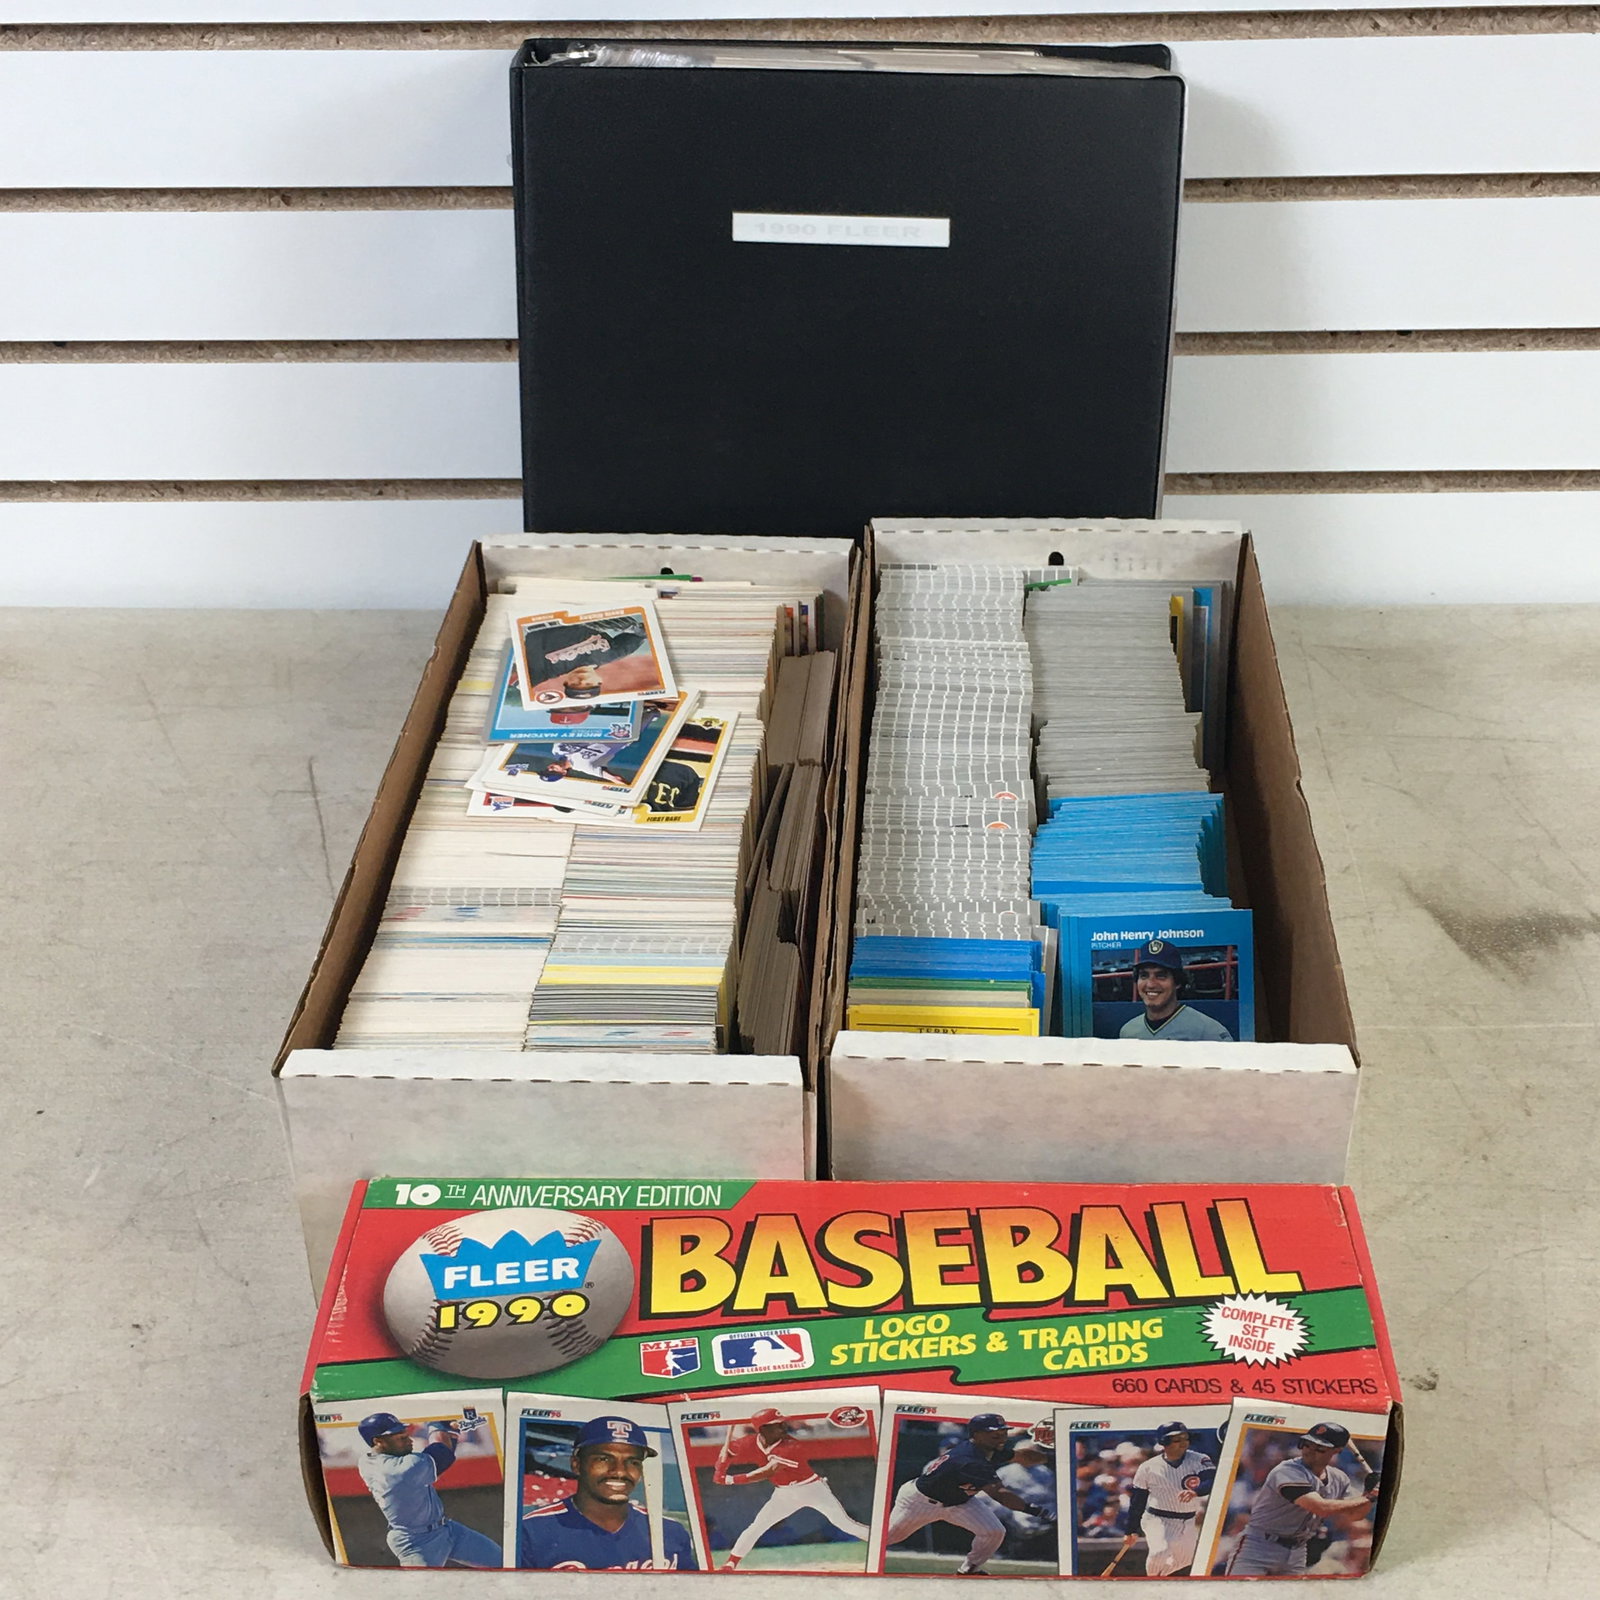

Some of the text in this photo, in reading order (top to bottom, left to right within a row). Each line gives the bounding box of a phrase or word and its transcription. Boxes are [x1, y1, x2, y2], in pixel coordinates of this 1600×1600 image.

[755, 222, 921, 239] 1990 FLEER
[561, 731, 603, 739] MICKEY
[1091, 929, 1205, 941] John Henry Johnson
[1091, 941, 1122, 949] PITCHER
[395, 1183, 722, 1207] 10 TH ANNIVERSARY EDITION
[640, 1198, 1304, 1320] BASEBALL
[443, 1257, 580, 1290] FLEER
[436, 1292, 590, 1331] 1990
[1221, 1305, 1296, 1332] COMPLETE
[729, 1330, 757, 1340] OFFICIAL
[863, 1313, 951, 1340] LOGO
[1241, 1324, 1267, 1339] SET
[641, 1337, 698, 1351] MLB
[830, 1317, 1164, 1366] STICKERS & TRADING
[1228, 1335, 1276, 1355] INSIDE
[1043, 1341, 1149, 1371] CARDS
[772, 1363, 806, 1371] BASEBALL
[1112, 1378, 1379, 1395] 660 CARDS & 45 STICKERS
[458, 1416, 488, 1431] Royals
[606, 1420, 633, 1439] T
